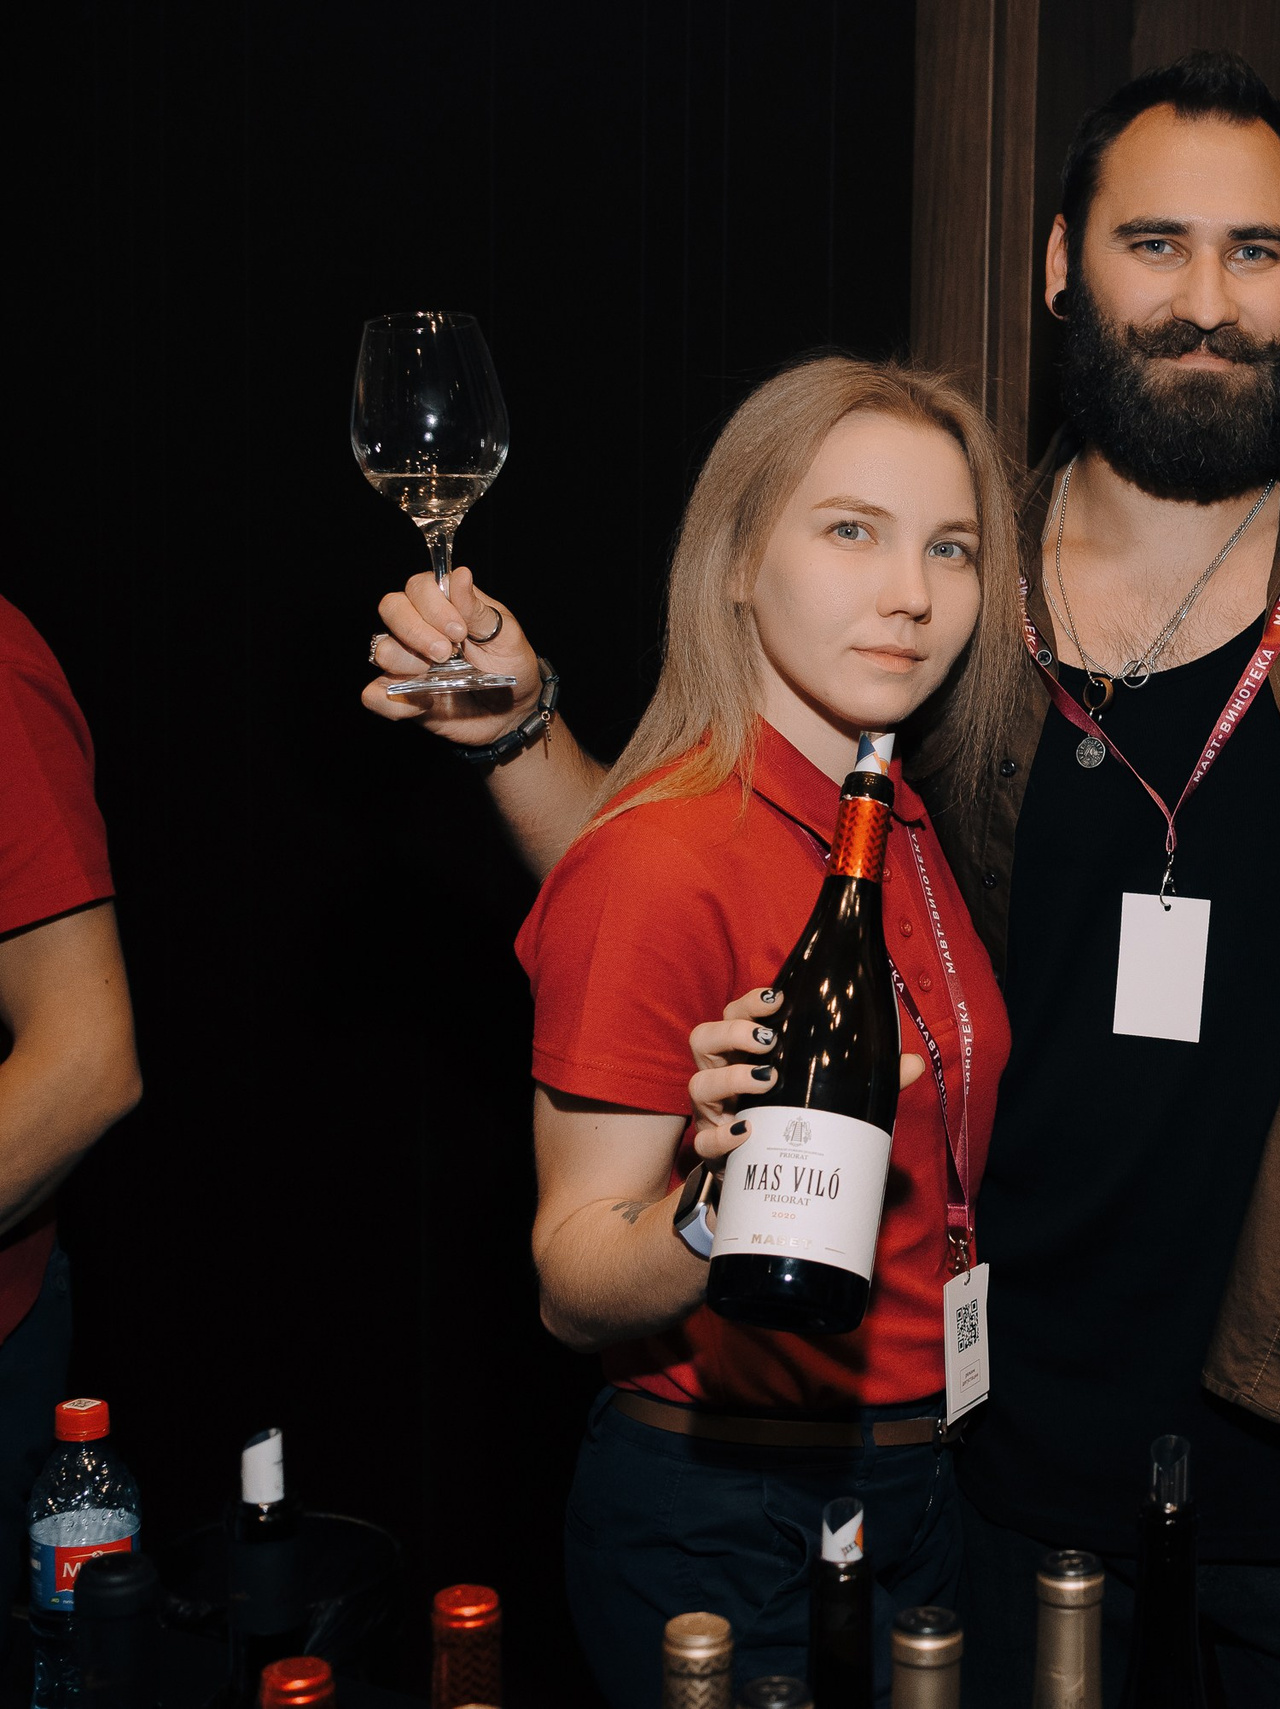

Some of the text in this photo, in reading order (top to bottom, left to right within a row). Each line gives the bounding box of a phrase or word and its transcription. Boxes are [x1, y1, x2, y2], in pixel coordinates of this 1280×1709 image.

[743, 1164, 841, 1200] MAS VILÓ
[764, 1194, 811, 1206] PRIORAT
[771, 1211, 796, 1220] 2020
[751, 1233, 813, 1250] MASET
